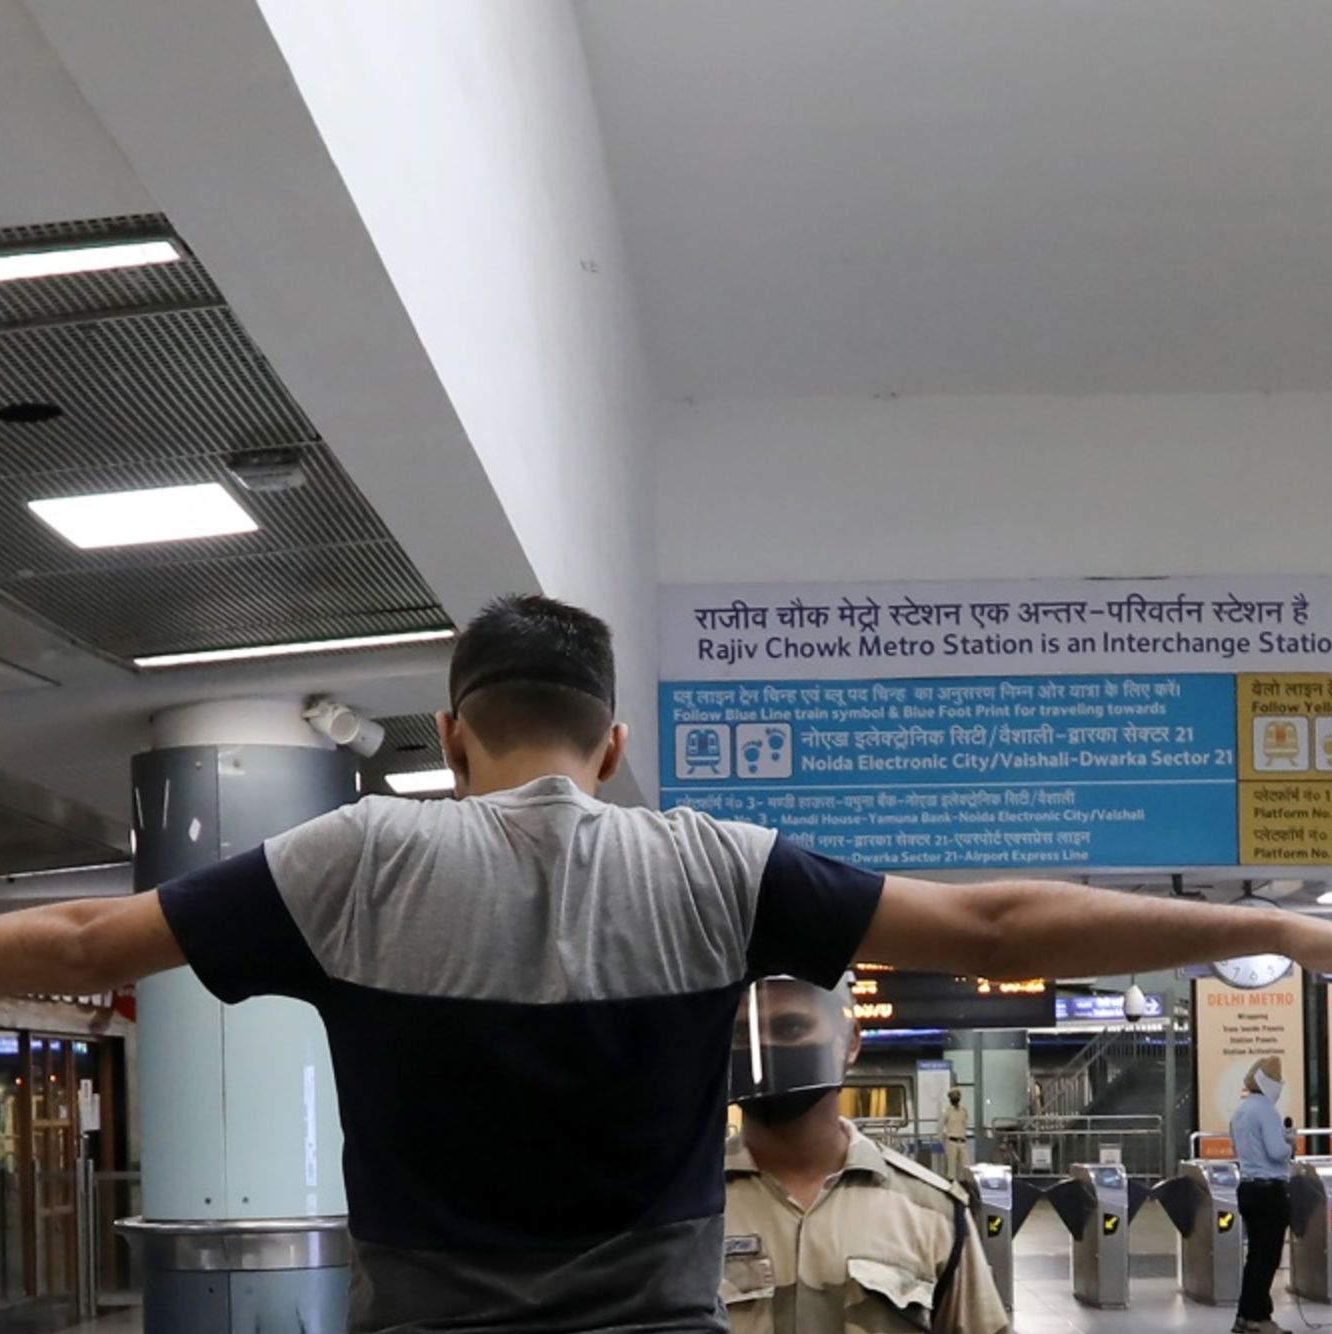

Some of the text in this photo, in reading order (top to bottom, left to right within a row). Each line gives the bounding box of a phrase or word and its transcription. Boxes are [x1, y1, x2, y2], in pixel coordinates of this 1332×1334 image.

[695, 592, 1310, 632] राजीव चौक मेट्रो स्टेशन एक अन्तर-परिवर्तन स्टेशन है
[698, 638, 758, 664] Rajiv
[766, 636, 851, 659] Chowk
[859, 636, 935, 657] Metro
[943, 634, 1032, 656] Station
[1041, 634, 1059, 654] is
[1068, 637, 1095, 653] an
[1103, 633, 1250, 658] Interchange
[697, 689, 734, 706] लाइन
[914, 687, 933, 701] का
[673, 702, 1166, 722] Follow Blue Line train symbol & Blue Foot Print for traveling towards
[1252, 702, 1298, 714] Follow
[1123, 721, 1170, 744] सेक्टर
[1175, 726, 1194, 742] 21
[801, 748, 1233, 772] Noida Electronic City/Vaishali-Dwarka Sector 21
[781, 813, 819, 826] Mandi
[998, 809, 1060, 823] Electronic
[1254, 807, 1309, 819] Platform
[1312, 807, 1332, 819] No.
[901, 851, 941, 863] Sector
[1011, 849, 1059, 864] Express
[1062, 849, 1089, 861] Line
[1254, 847, 1308, 859] Platform
[1311, 847, 1331, 859] No.
[1207, 992, 1294, 1007] DELHI METRO
